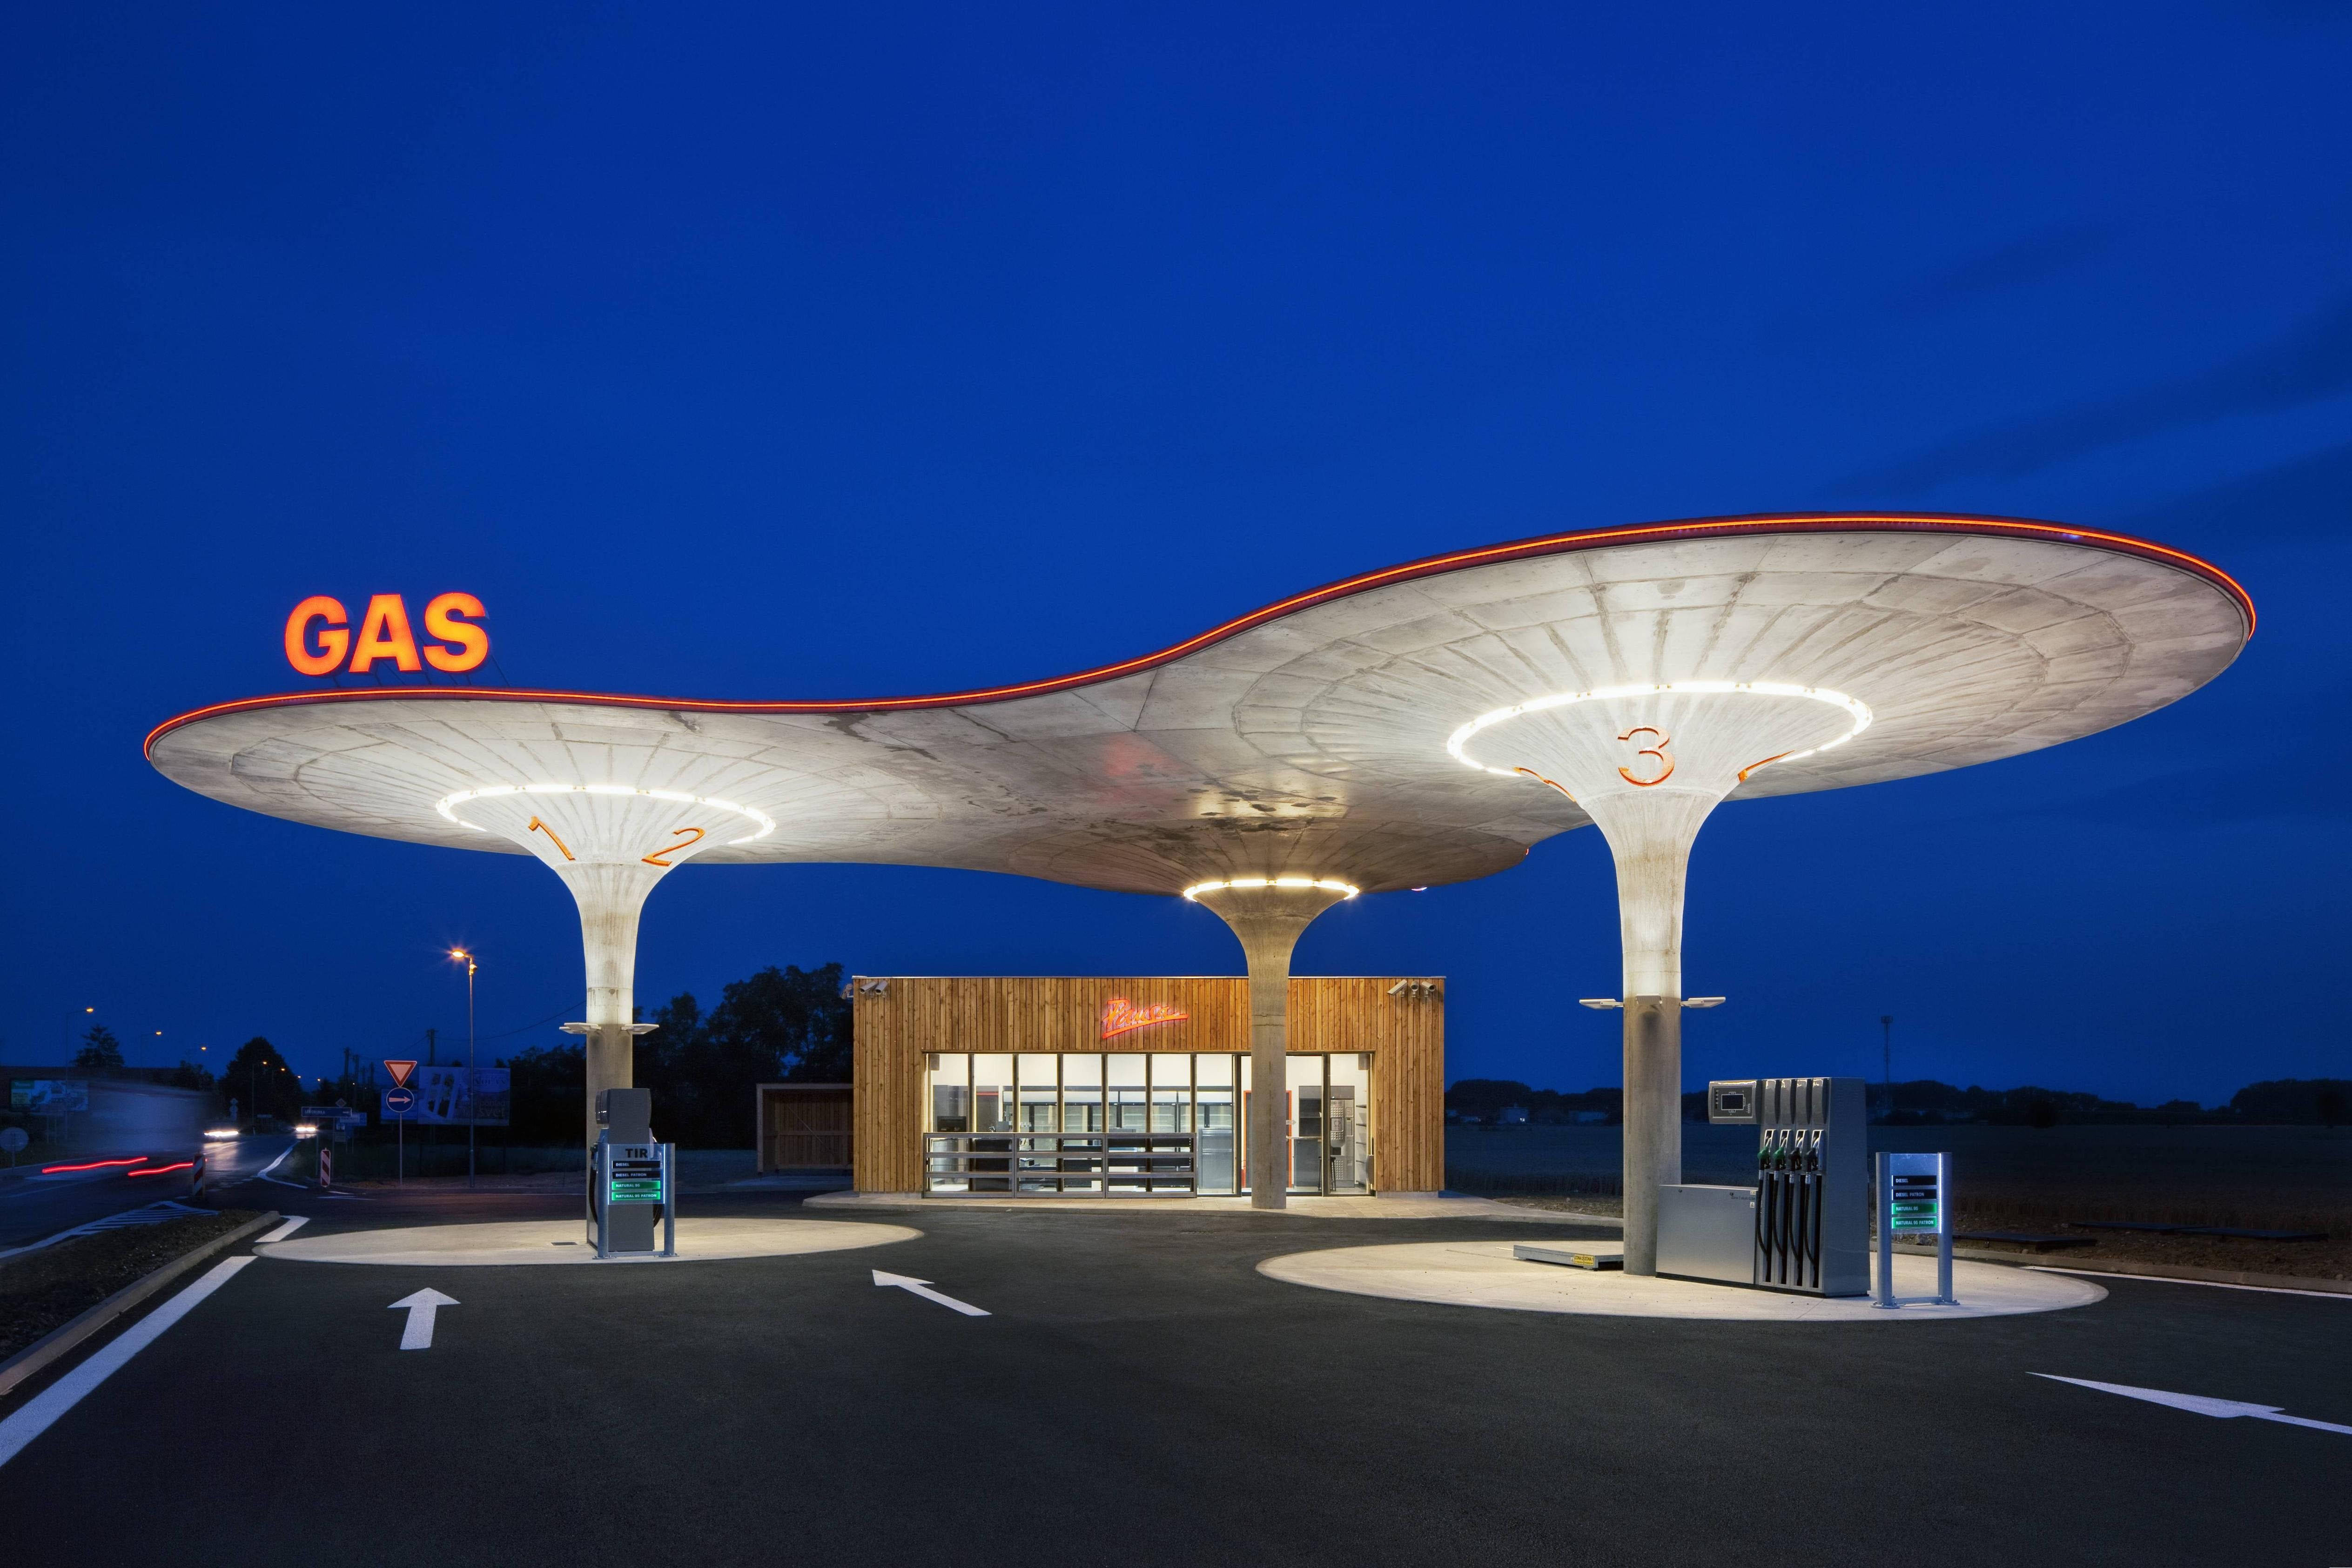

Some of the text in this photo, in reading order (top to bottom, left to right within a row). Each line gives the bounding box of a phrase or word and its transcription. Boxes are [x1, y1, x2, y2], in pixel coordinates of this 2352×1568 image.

[284, 591, 489, 676] GAS
[1618, 725, 1675, 786] 3
[528, 816, 575, 860] 1
[641, 827, 705, 866] 2
[625, 1148, 648, 1158] TIR
